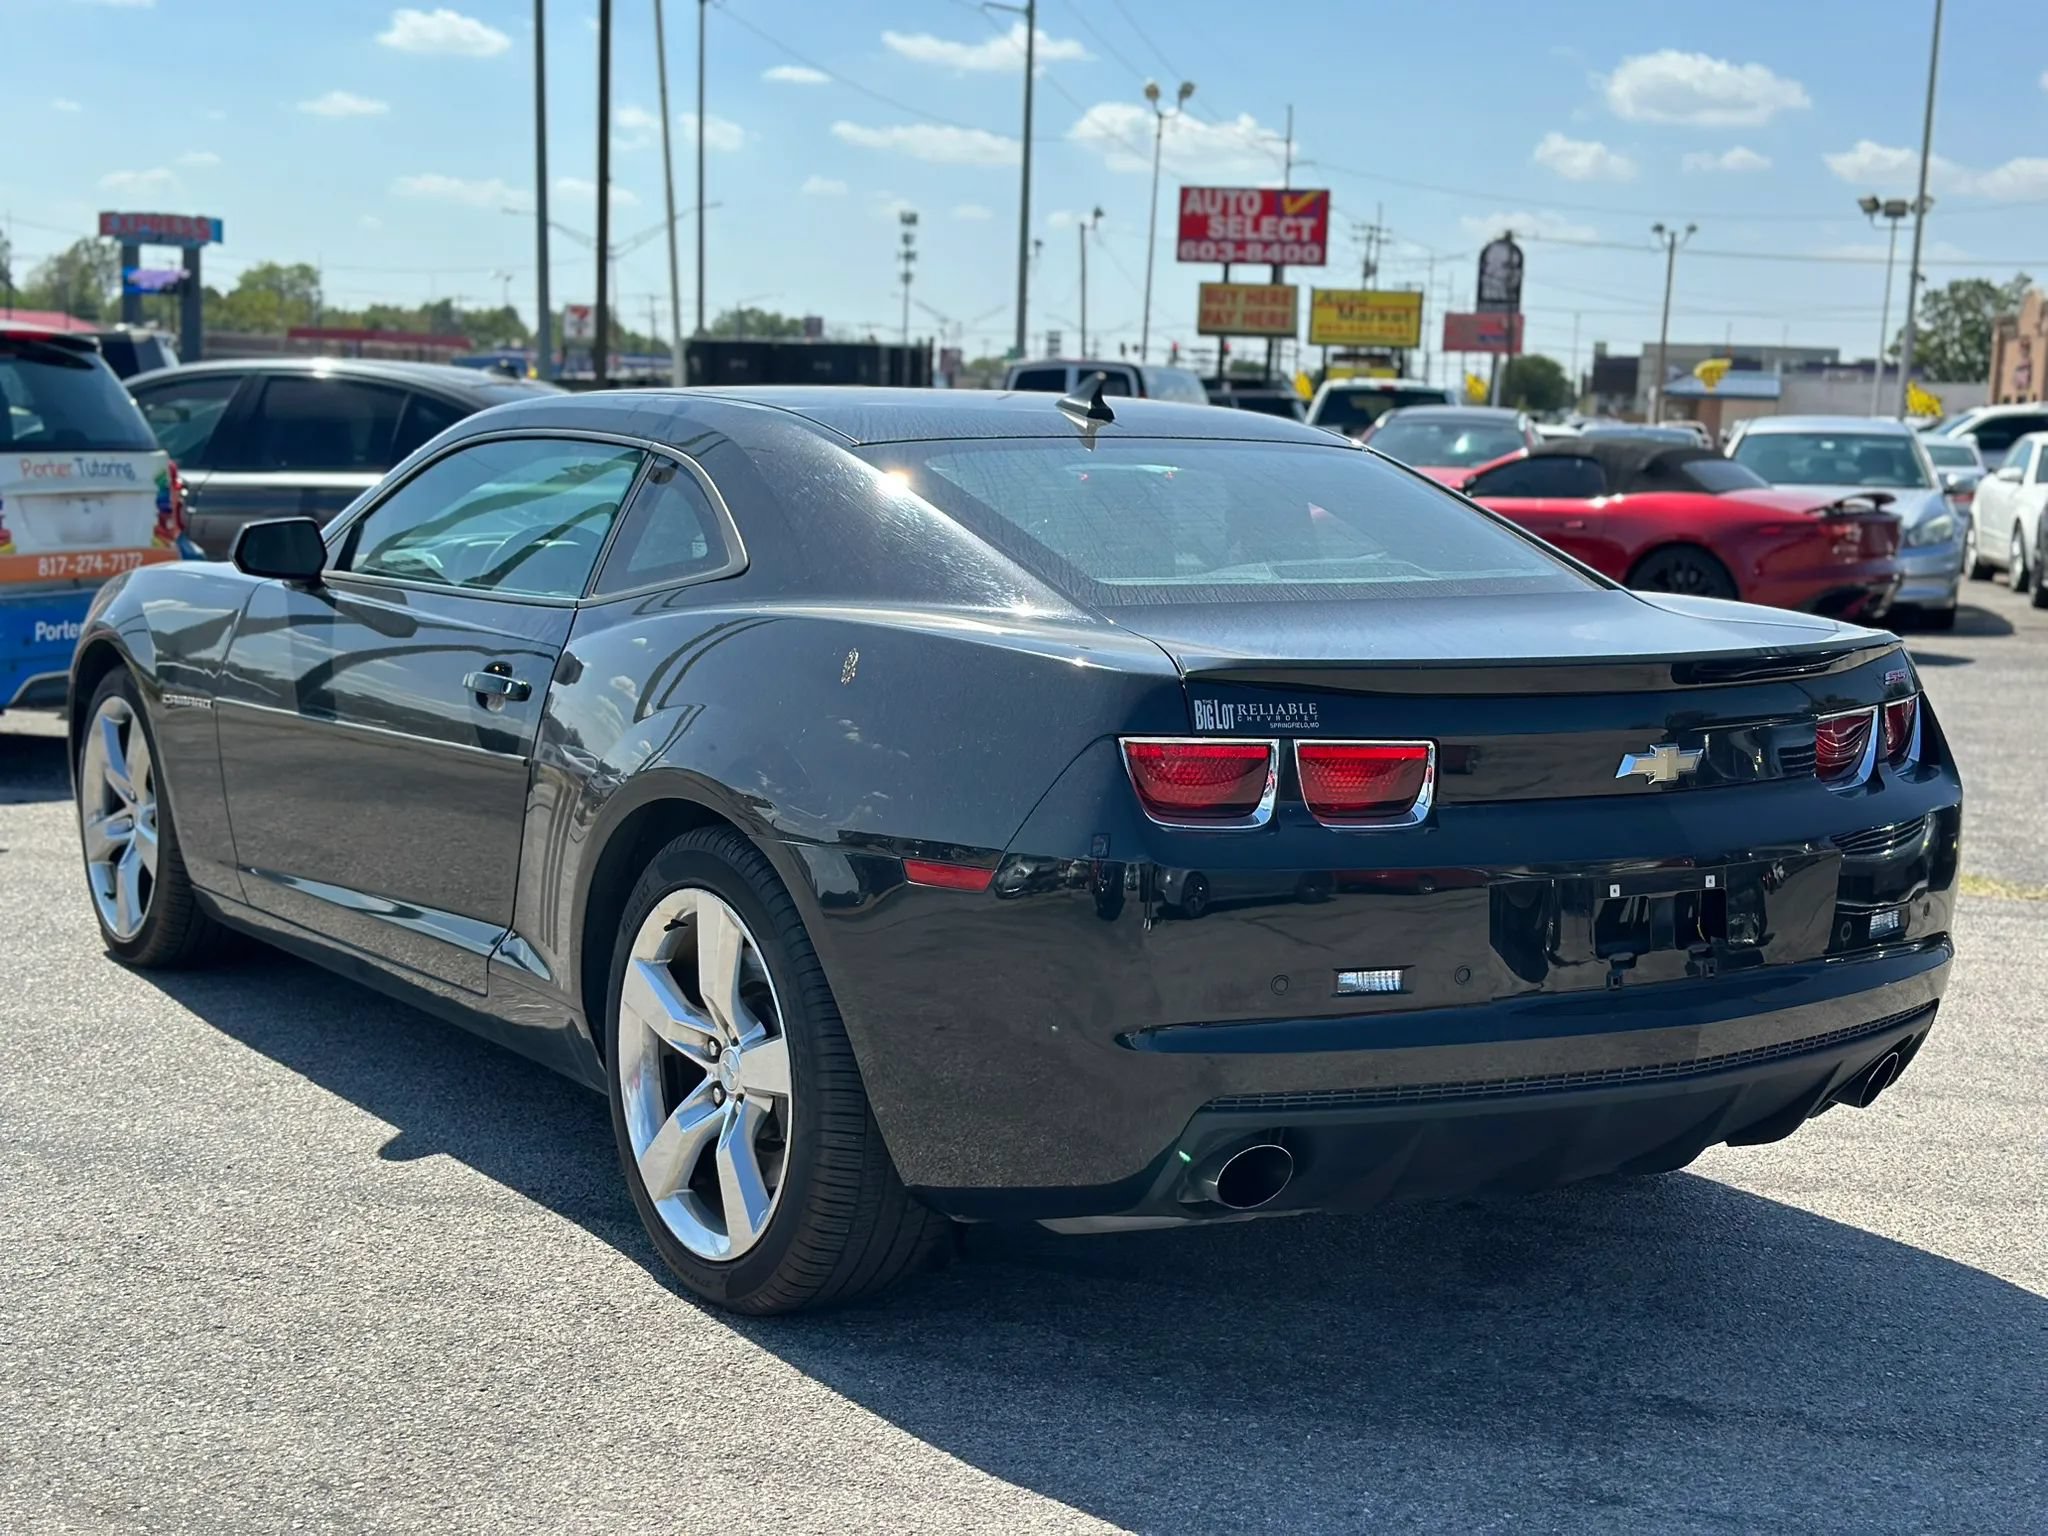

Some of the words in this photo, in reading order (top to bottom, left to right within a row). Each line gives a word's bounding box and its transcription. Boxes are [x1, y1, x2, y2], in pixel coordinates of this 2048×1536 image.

[1184, 189, 1262, 215] AUTO
[1208, 216, 1317, 240] SELECT
[20, 458, 72, 478] Porter
[75, 457, 136, 481] Tutoring
[1237, 703, 1318, 716] RELIABLE
